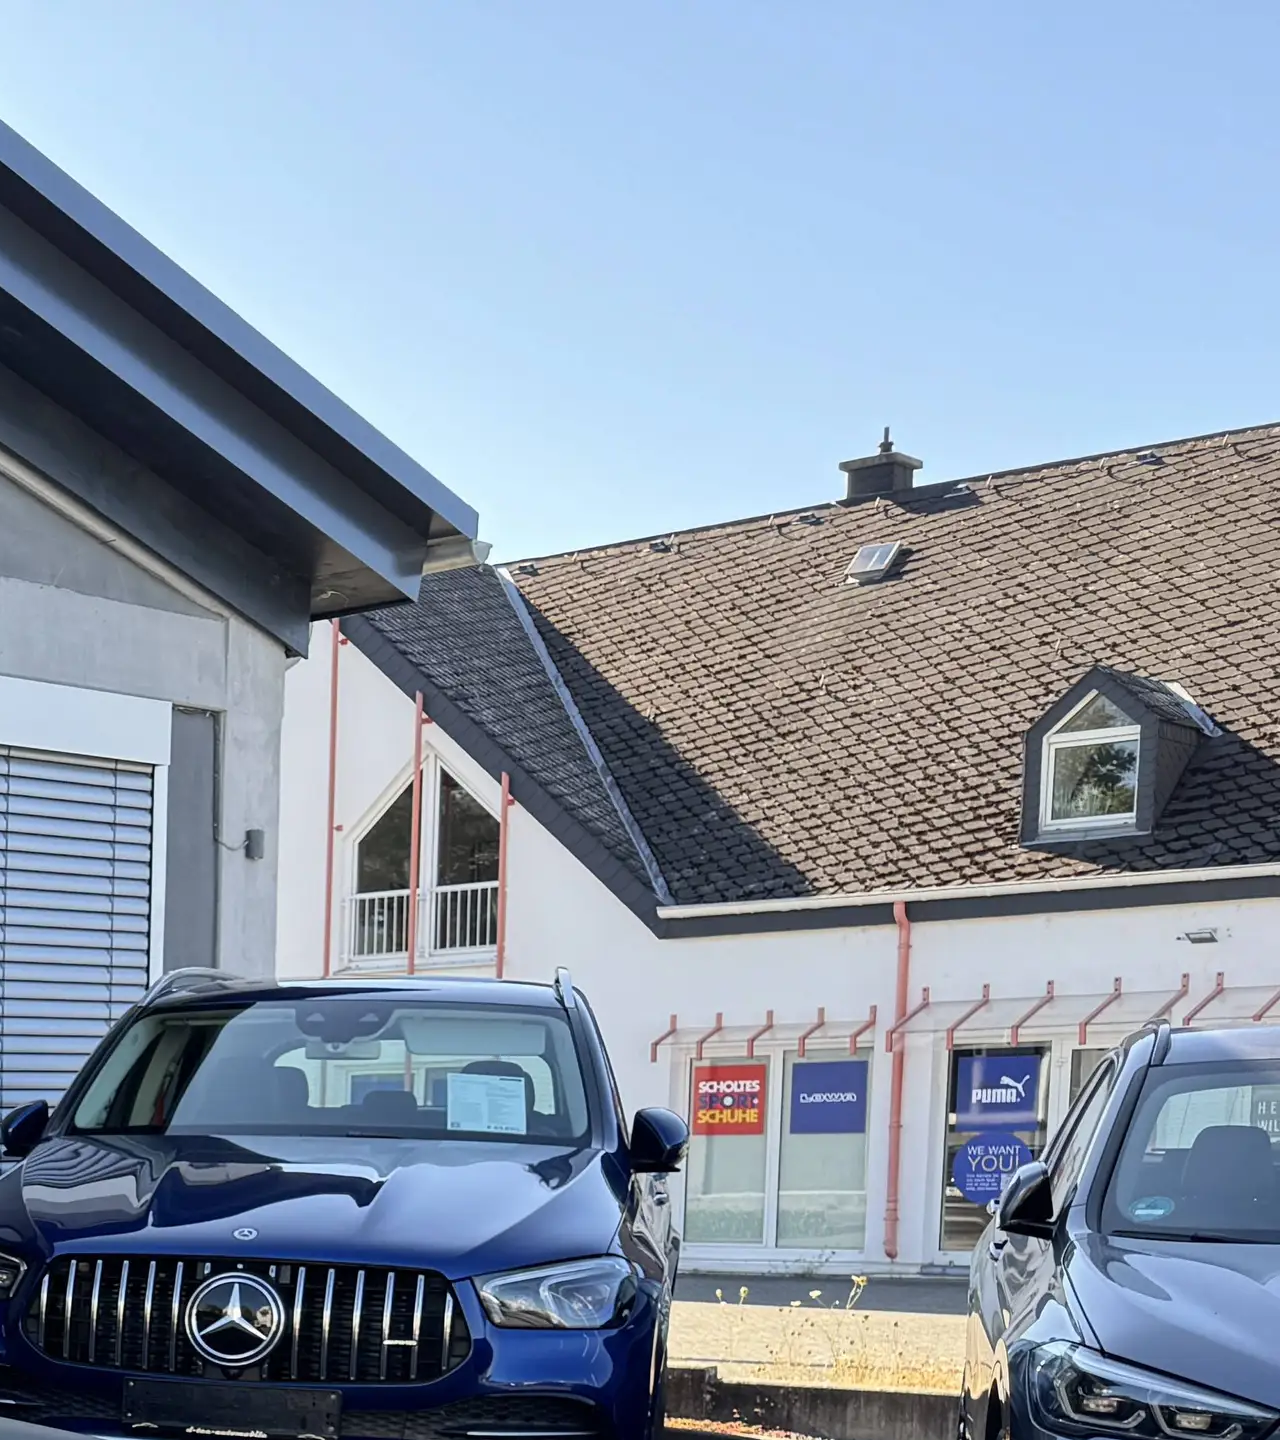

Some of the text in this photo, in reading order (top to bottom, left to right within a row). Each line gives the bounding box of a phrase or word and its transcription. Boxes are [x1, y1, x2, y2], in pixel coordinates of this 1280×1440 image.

[698, 1080, 761, 1093] SCHOLTES
[971, 1088, 1017, 1104] PUMA
[697, 1109, 759, 1123] SCHUHE
[967, 1145, 1022, 1156] WE WANT
[967, 1155, 1021, 1173] YOU!
